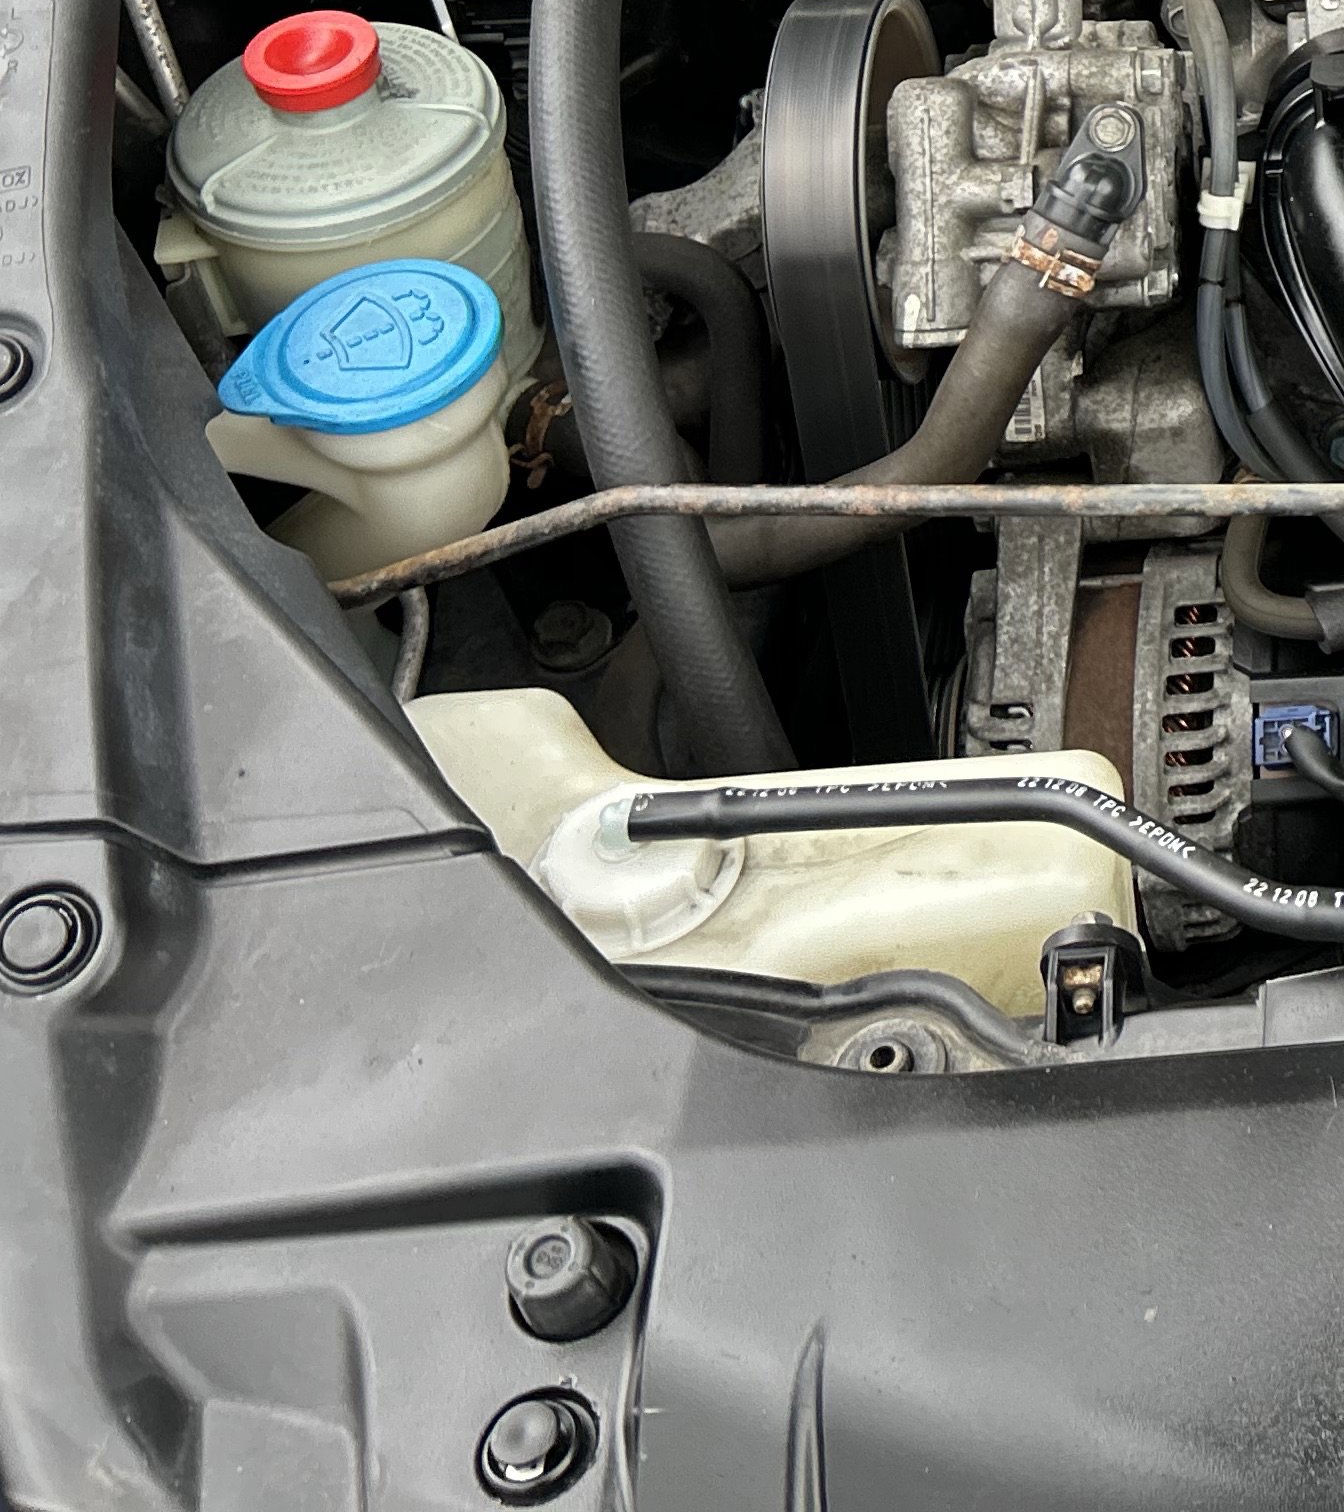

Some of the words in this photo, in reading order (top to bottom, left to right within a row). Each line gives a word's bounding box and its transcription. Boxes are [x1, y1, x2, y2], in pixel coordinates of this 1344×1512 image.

[1091, 793, 1127, 819] TPC
[1242, 876, 1269, 897] 22
[1271, 886, 1291, 905] 12
